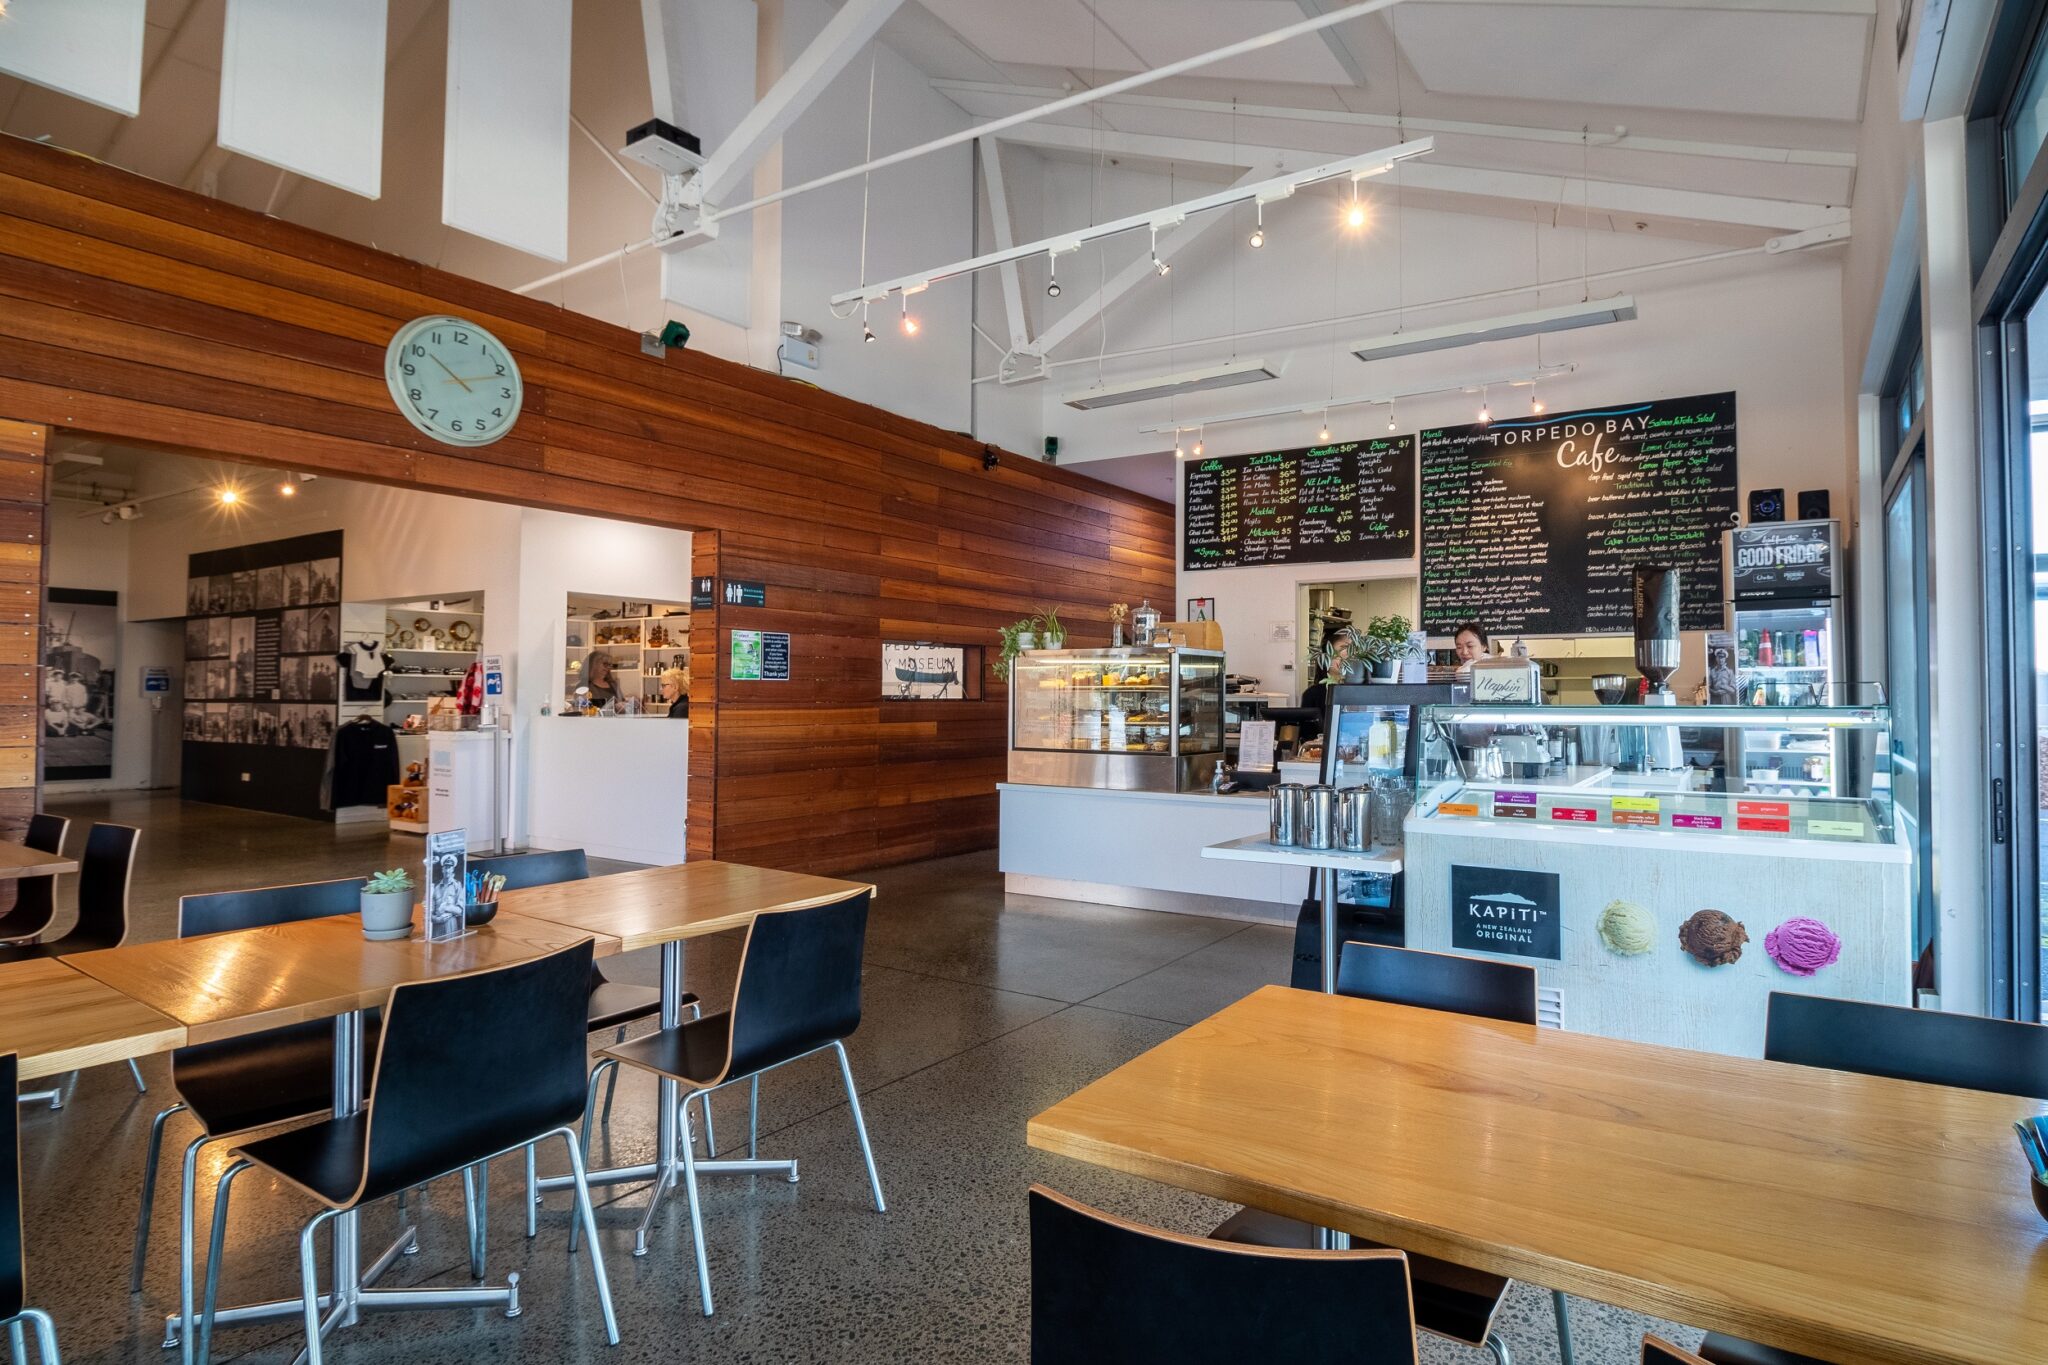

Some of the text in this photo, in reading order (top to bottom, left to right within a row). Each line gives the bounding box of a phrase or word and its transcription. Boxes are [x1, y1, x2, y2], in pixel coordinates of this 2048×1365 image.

[432, 332, 441, 344] 11
[454, 331, 469, 345] 12
[412, 344, 425, 357] 10
[482, 345, 486, 355] 1
[404, 364, 415, 376] 9
[496, 364, 505, 377] 2
[411, 389, 422, 401] 8
[500, 388, 511, 399] 3
[428, 409, 438, 419] 7
[492, 408, 502, 417] 4
[451, 420, 463, 431] 6
[476, 419, 486, 430] 5
[1490, 416, 1650, 446] TORPEDO BAY
[1370, 439, 1409, 450] Beer $7
[1557, 432, 1620, 472] Cafe
[1201, 460, 1223, 471] Coffee
[1249, 506, 1276, 515] Mocktail
[1369, 521, 1390, 530] Cider
[1396, 529, 1409, 539] $7
[1738, 542, 1824, 568] GOOD FRIDGE
[1196, 608, 1206, 622] A
[1477, 676, 1526, 702] Napkin
[1499, 926, 1532, 934] ZEALAND
[1476, 930, 1533, 944] ORIGINAL
